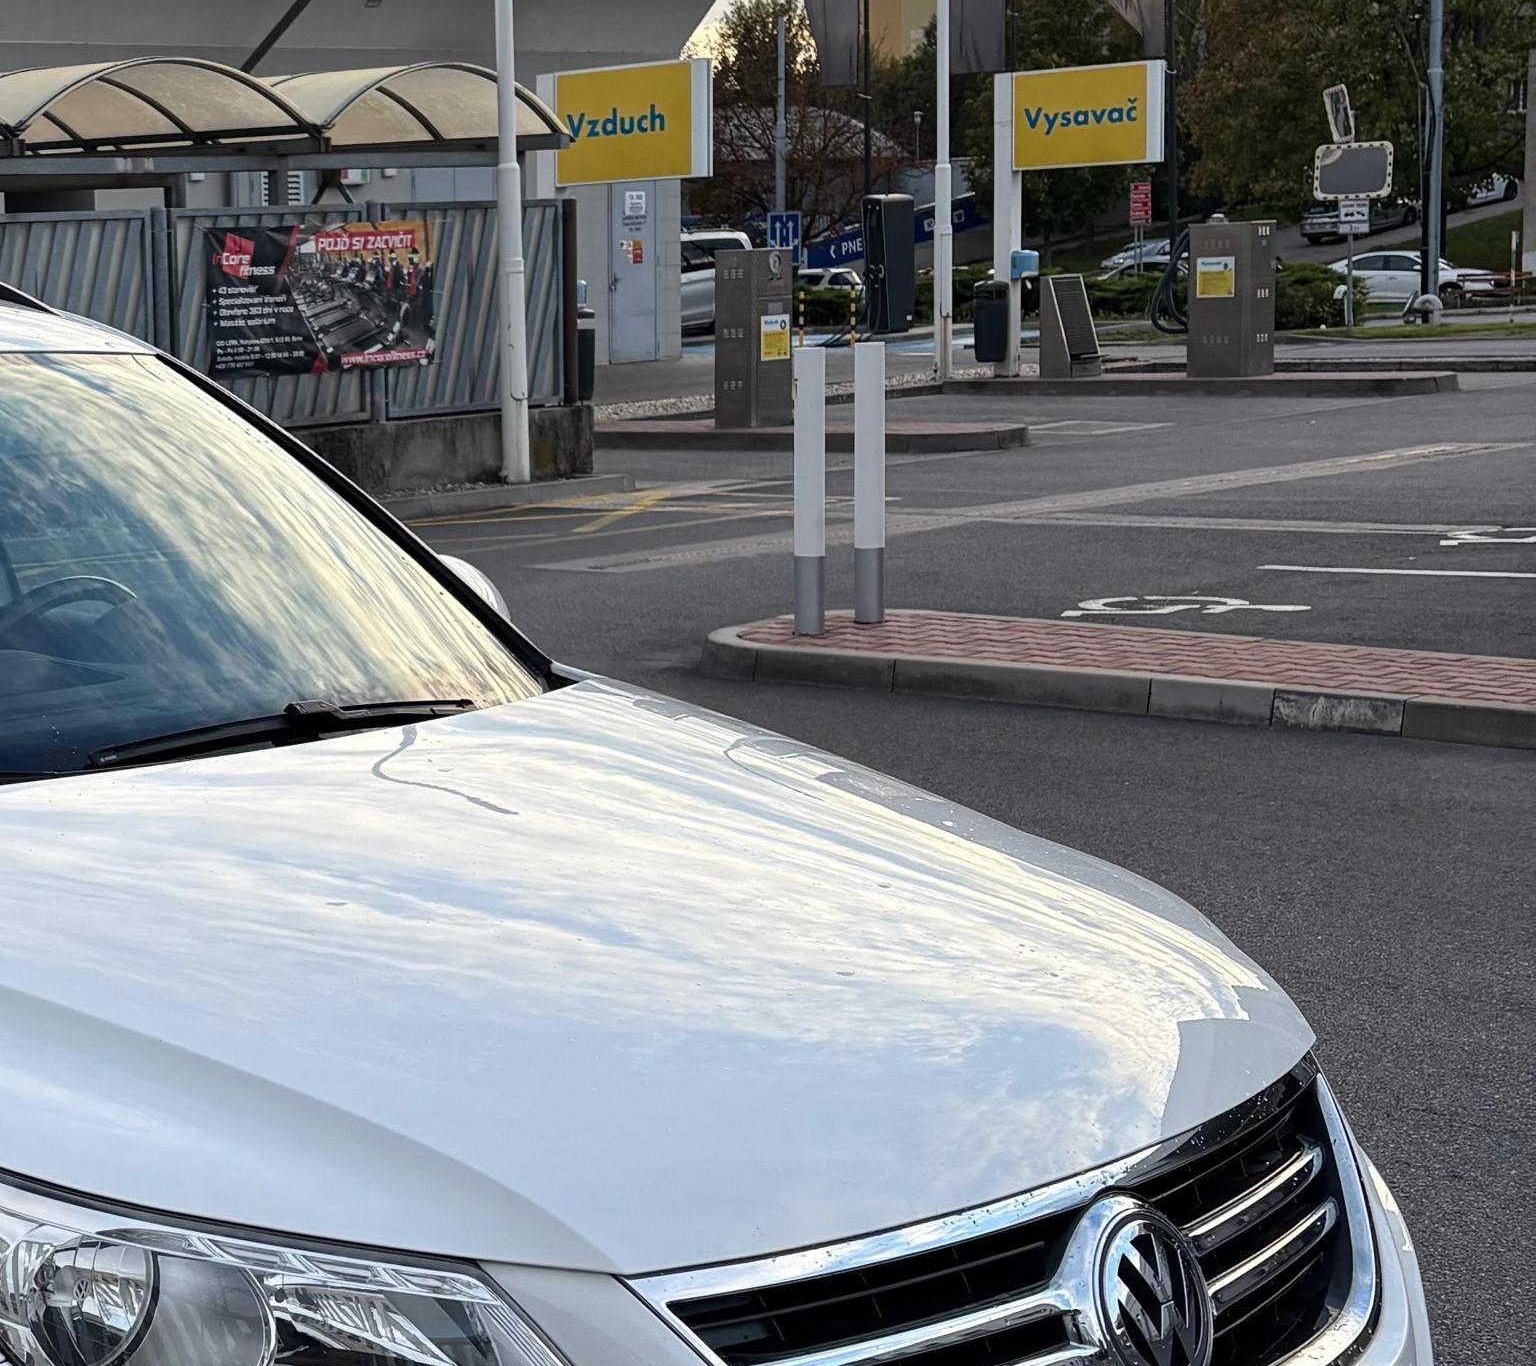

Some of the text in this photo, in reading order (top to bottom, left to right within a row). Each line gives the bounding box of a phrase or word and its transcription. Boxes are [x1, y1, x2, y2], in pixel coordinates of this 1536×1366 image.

[566, 103, 666, 140] Vzduch
[1023, 96, 1138, 136] Vysavač
[317, 233, 350, 251] POJĎ
[351, 238, 364, 249] SI
[841, 237, 864, 256] PNE
[211, 252, 251, 265] InCore
[239, 264, 276, 276] fitness
